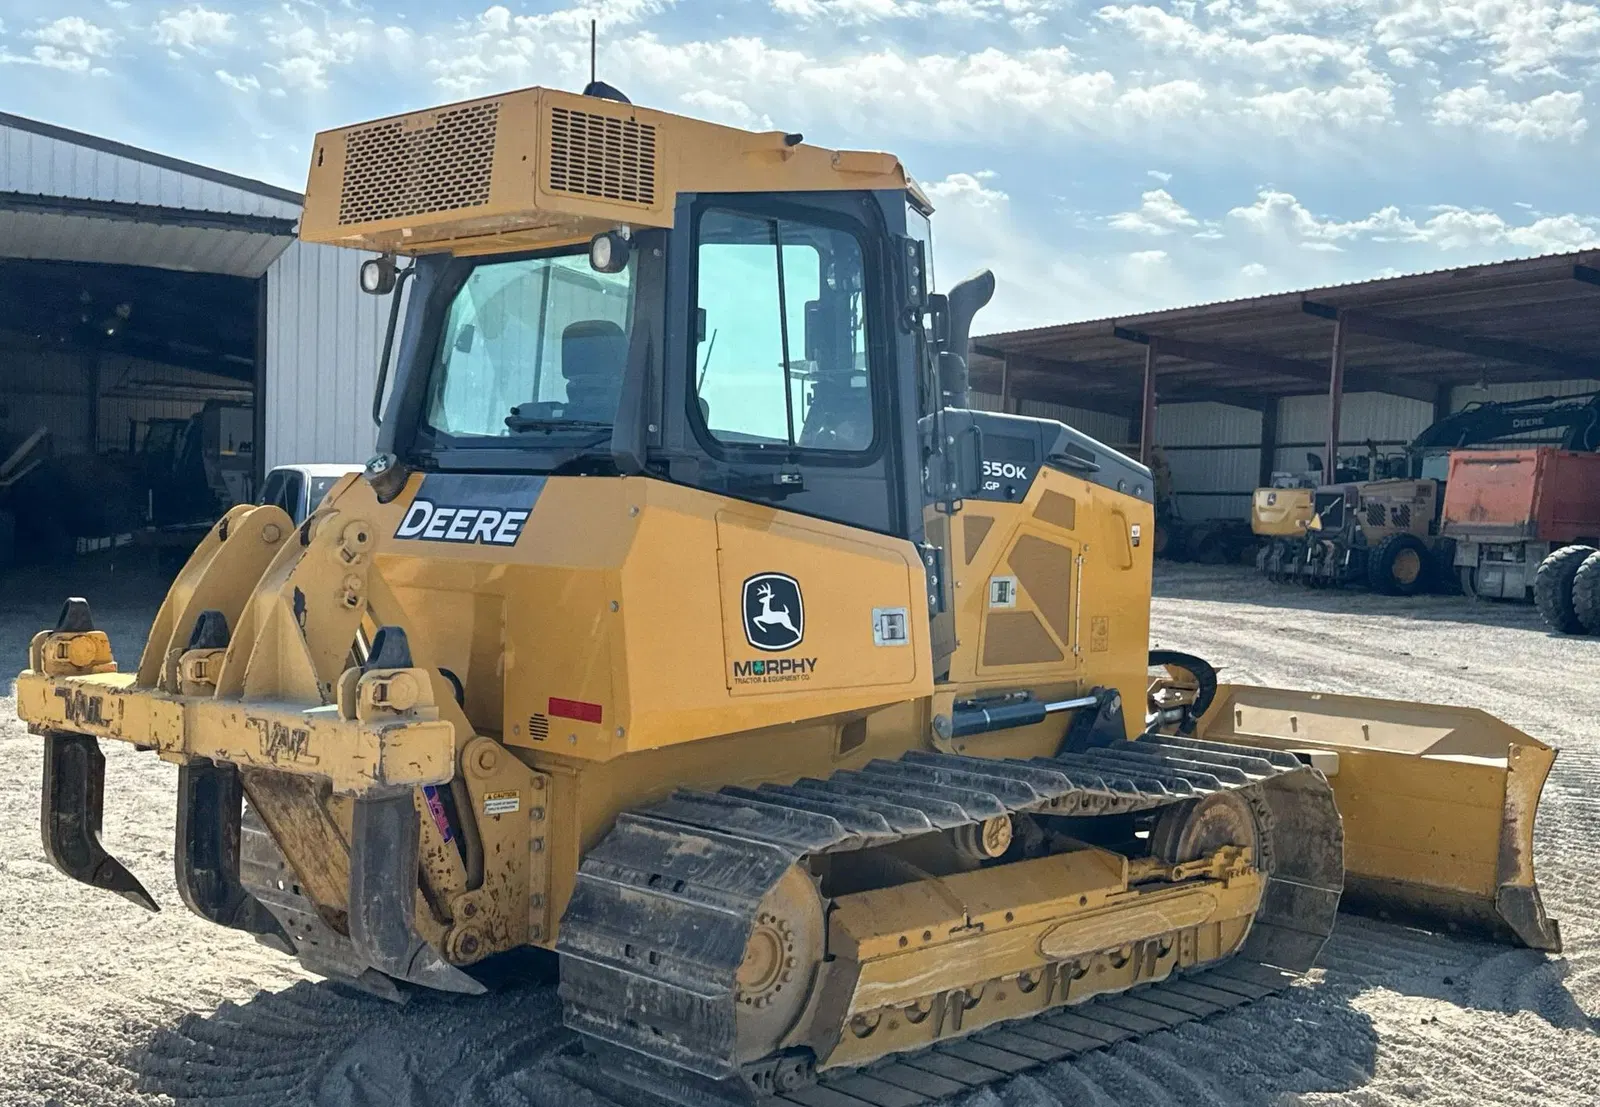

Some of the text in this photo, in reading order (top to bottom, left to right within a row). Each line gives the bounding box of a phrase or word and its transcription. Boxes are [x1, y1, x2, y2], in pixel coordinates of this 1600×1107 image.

[982, 481, 1000, 490] GP
[396, 500, 529, 543] DEERE
[733, 657, 818, 677] MURPHY
[734, 676, 762, 685] TRACTOR
[768, 674, 800, 683] EQUIPMENT
